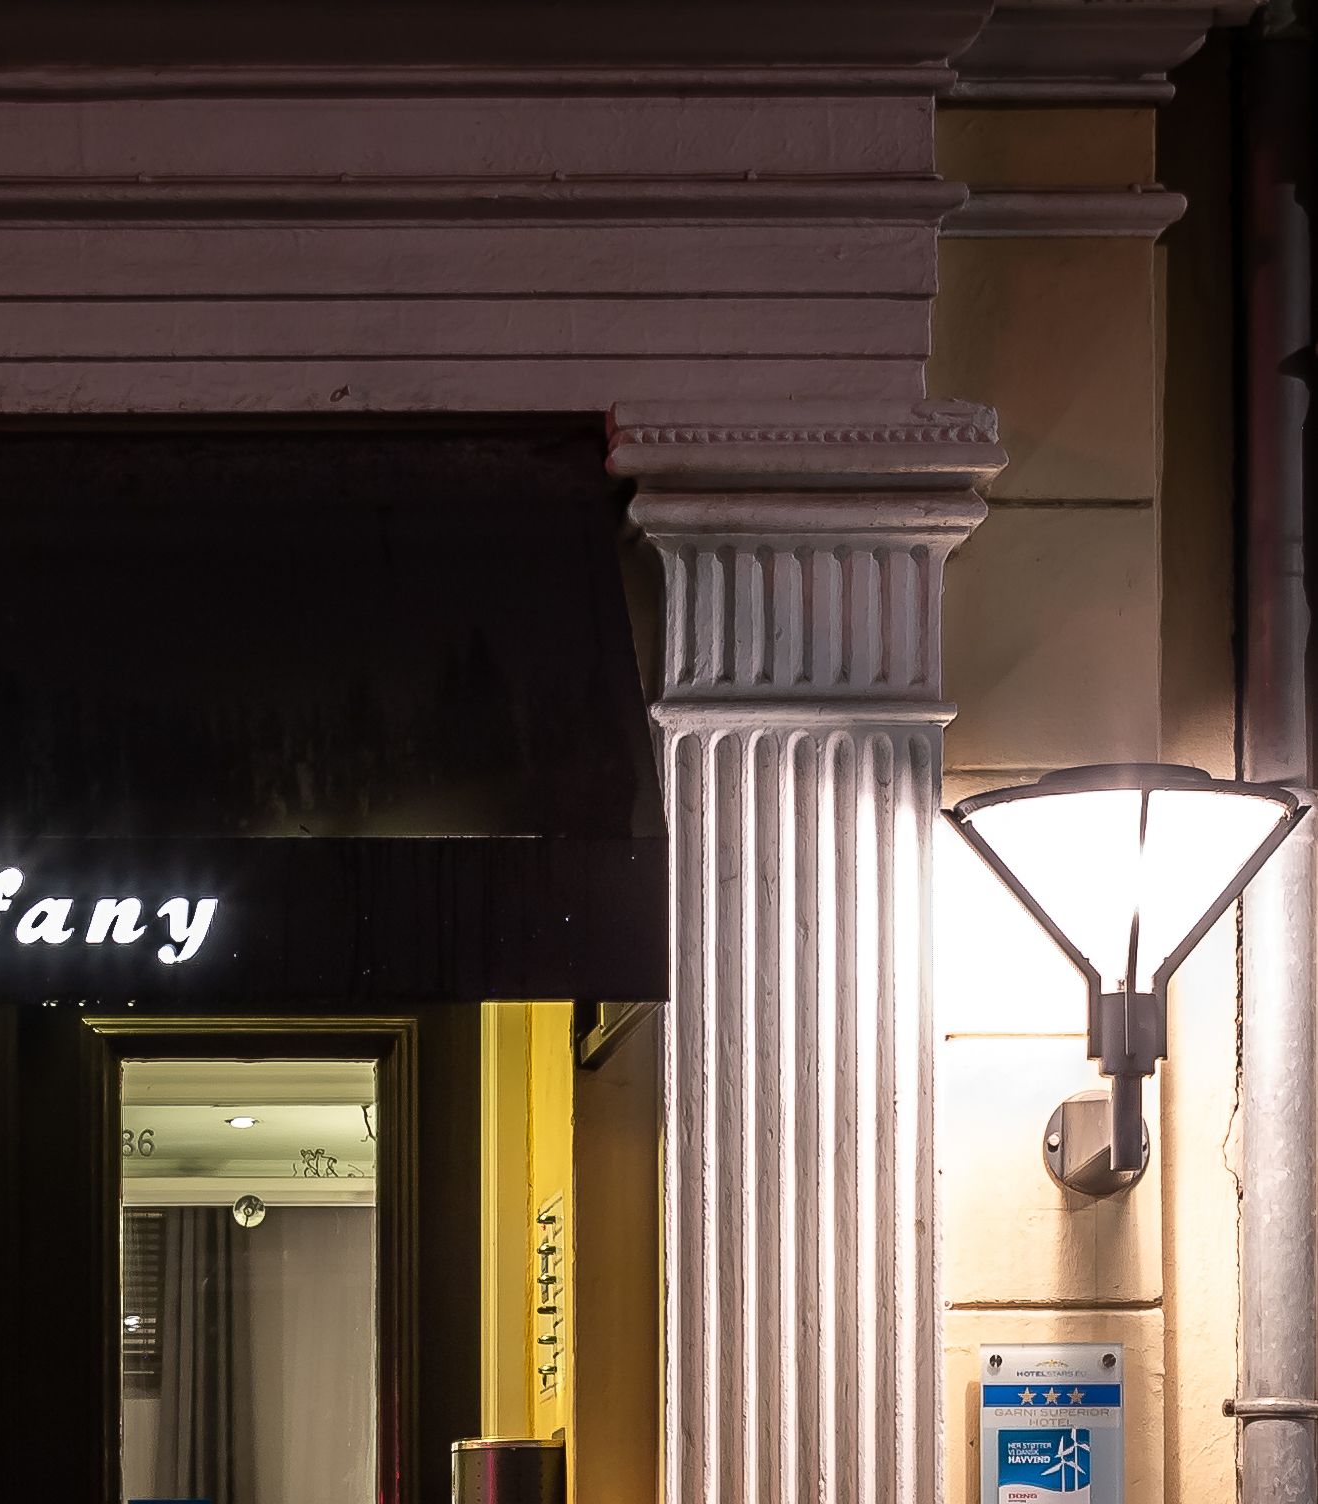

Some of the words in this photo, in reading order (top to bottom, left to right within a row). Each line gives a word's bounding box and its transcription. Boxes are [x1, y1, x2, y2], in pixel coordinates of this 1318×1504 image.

[994, 1408, 1037, 1417] GARNI
[1040, 1408, 1111, 1417] SUPERIOR
[1028, 1418, 1072, 1427] HOTEL
[1008, 1456, 1051, 1464] HAVVIND
